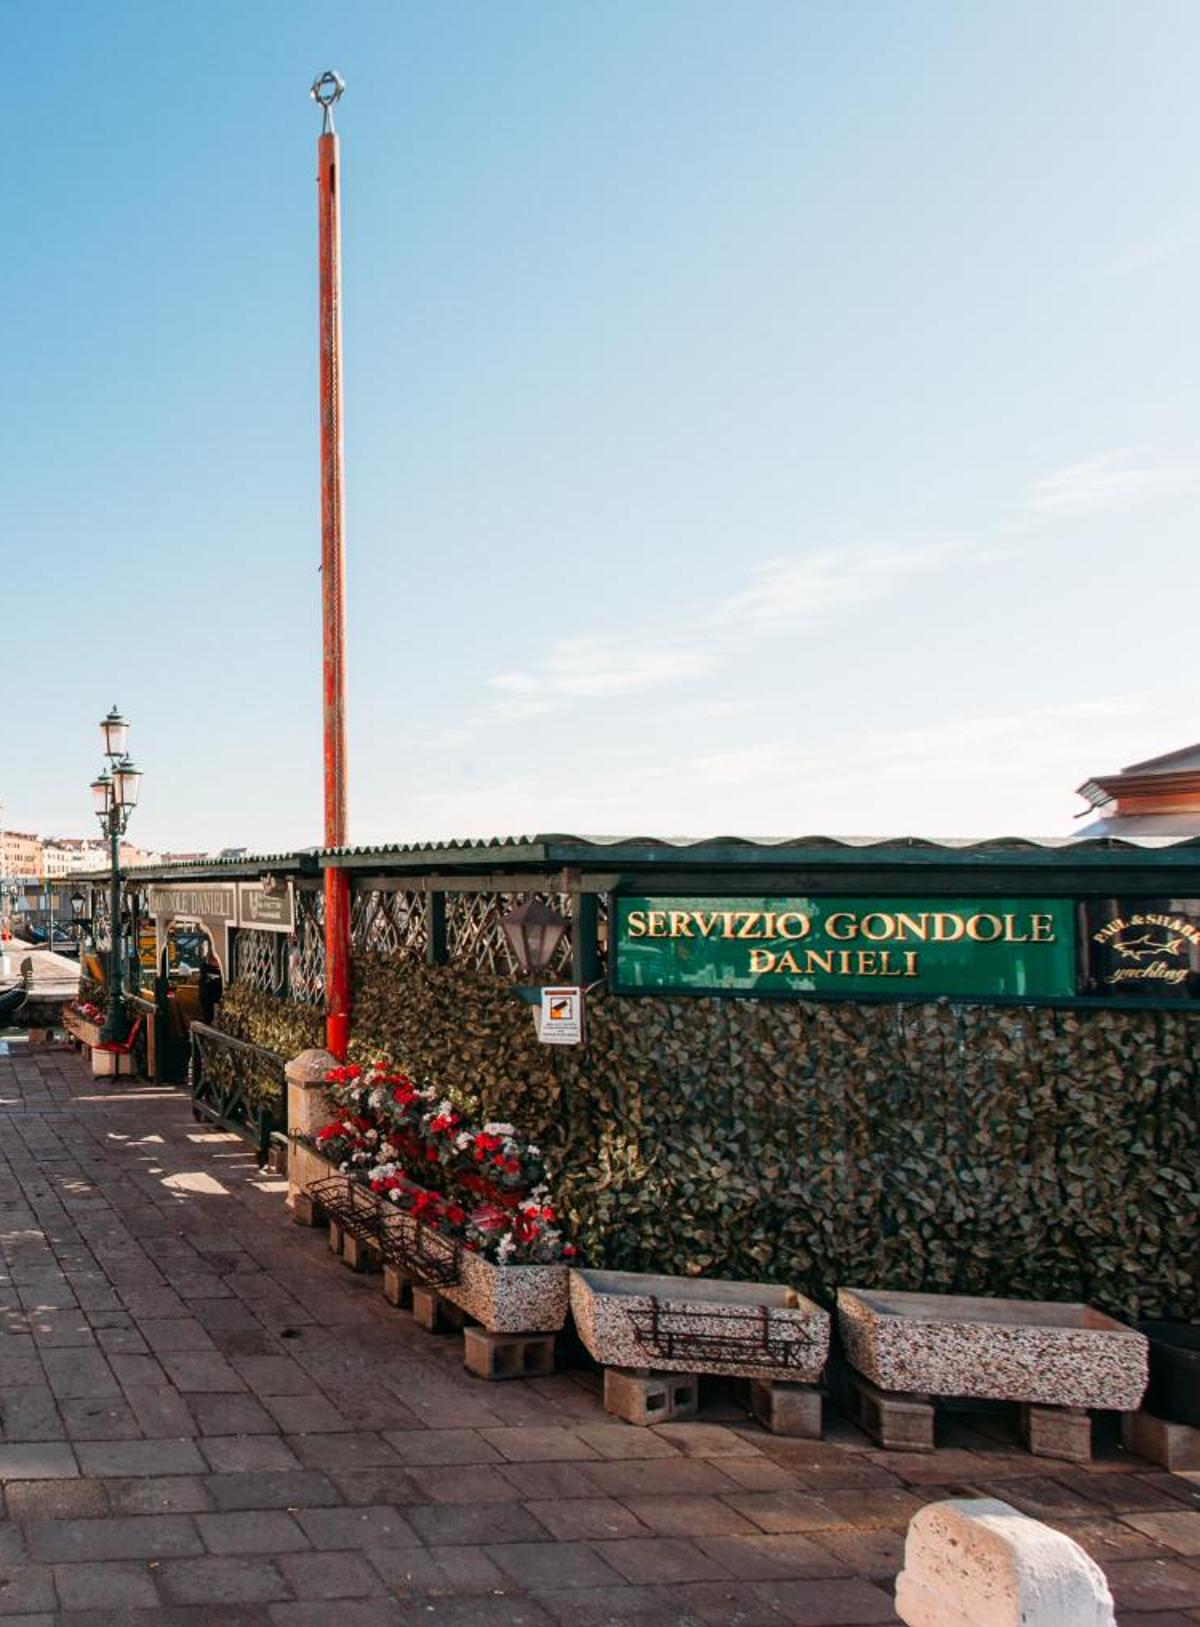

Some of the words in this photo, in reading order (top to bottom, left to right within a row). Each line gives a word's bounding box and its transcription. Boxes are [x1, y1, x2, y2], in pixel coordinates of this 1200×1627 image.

[627, 911, 809, 940] SERVIZIO
[825, 912, 1055, 942] GONDOLE
[1093, 919, 1129, 944] PAUL
[1131, 914, 1144, 925] &
[749, 949, 918, 976] DANIELI
[1103, 961, 1189, 985] yachting
